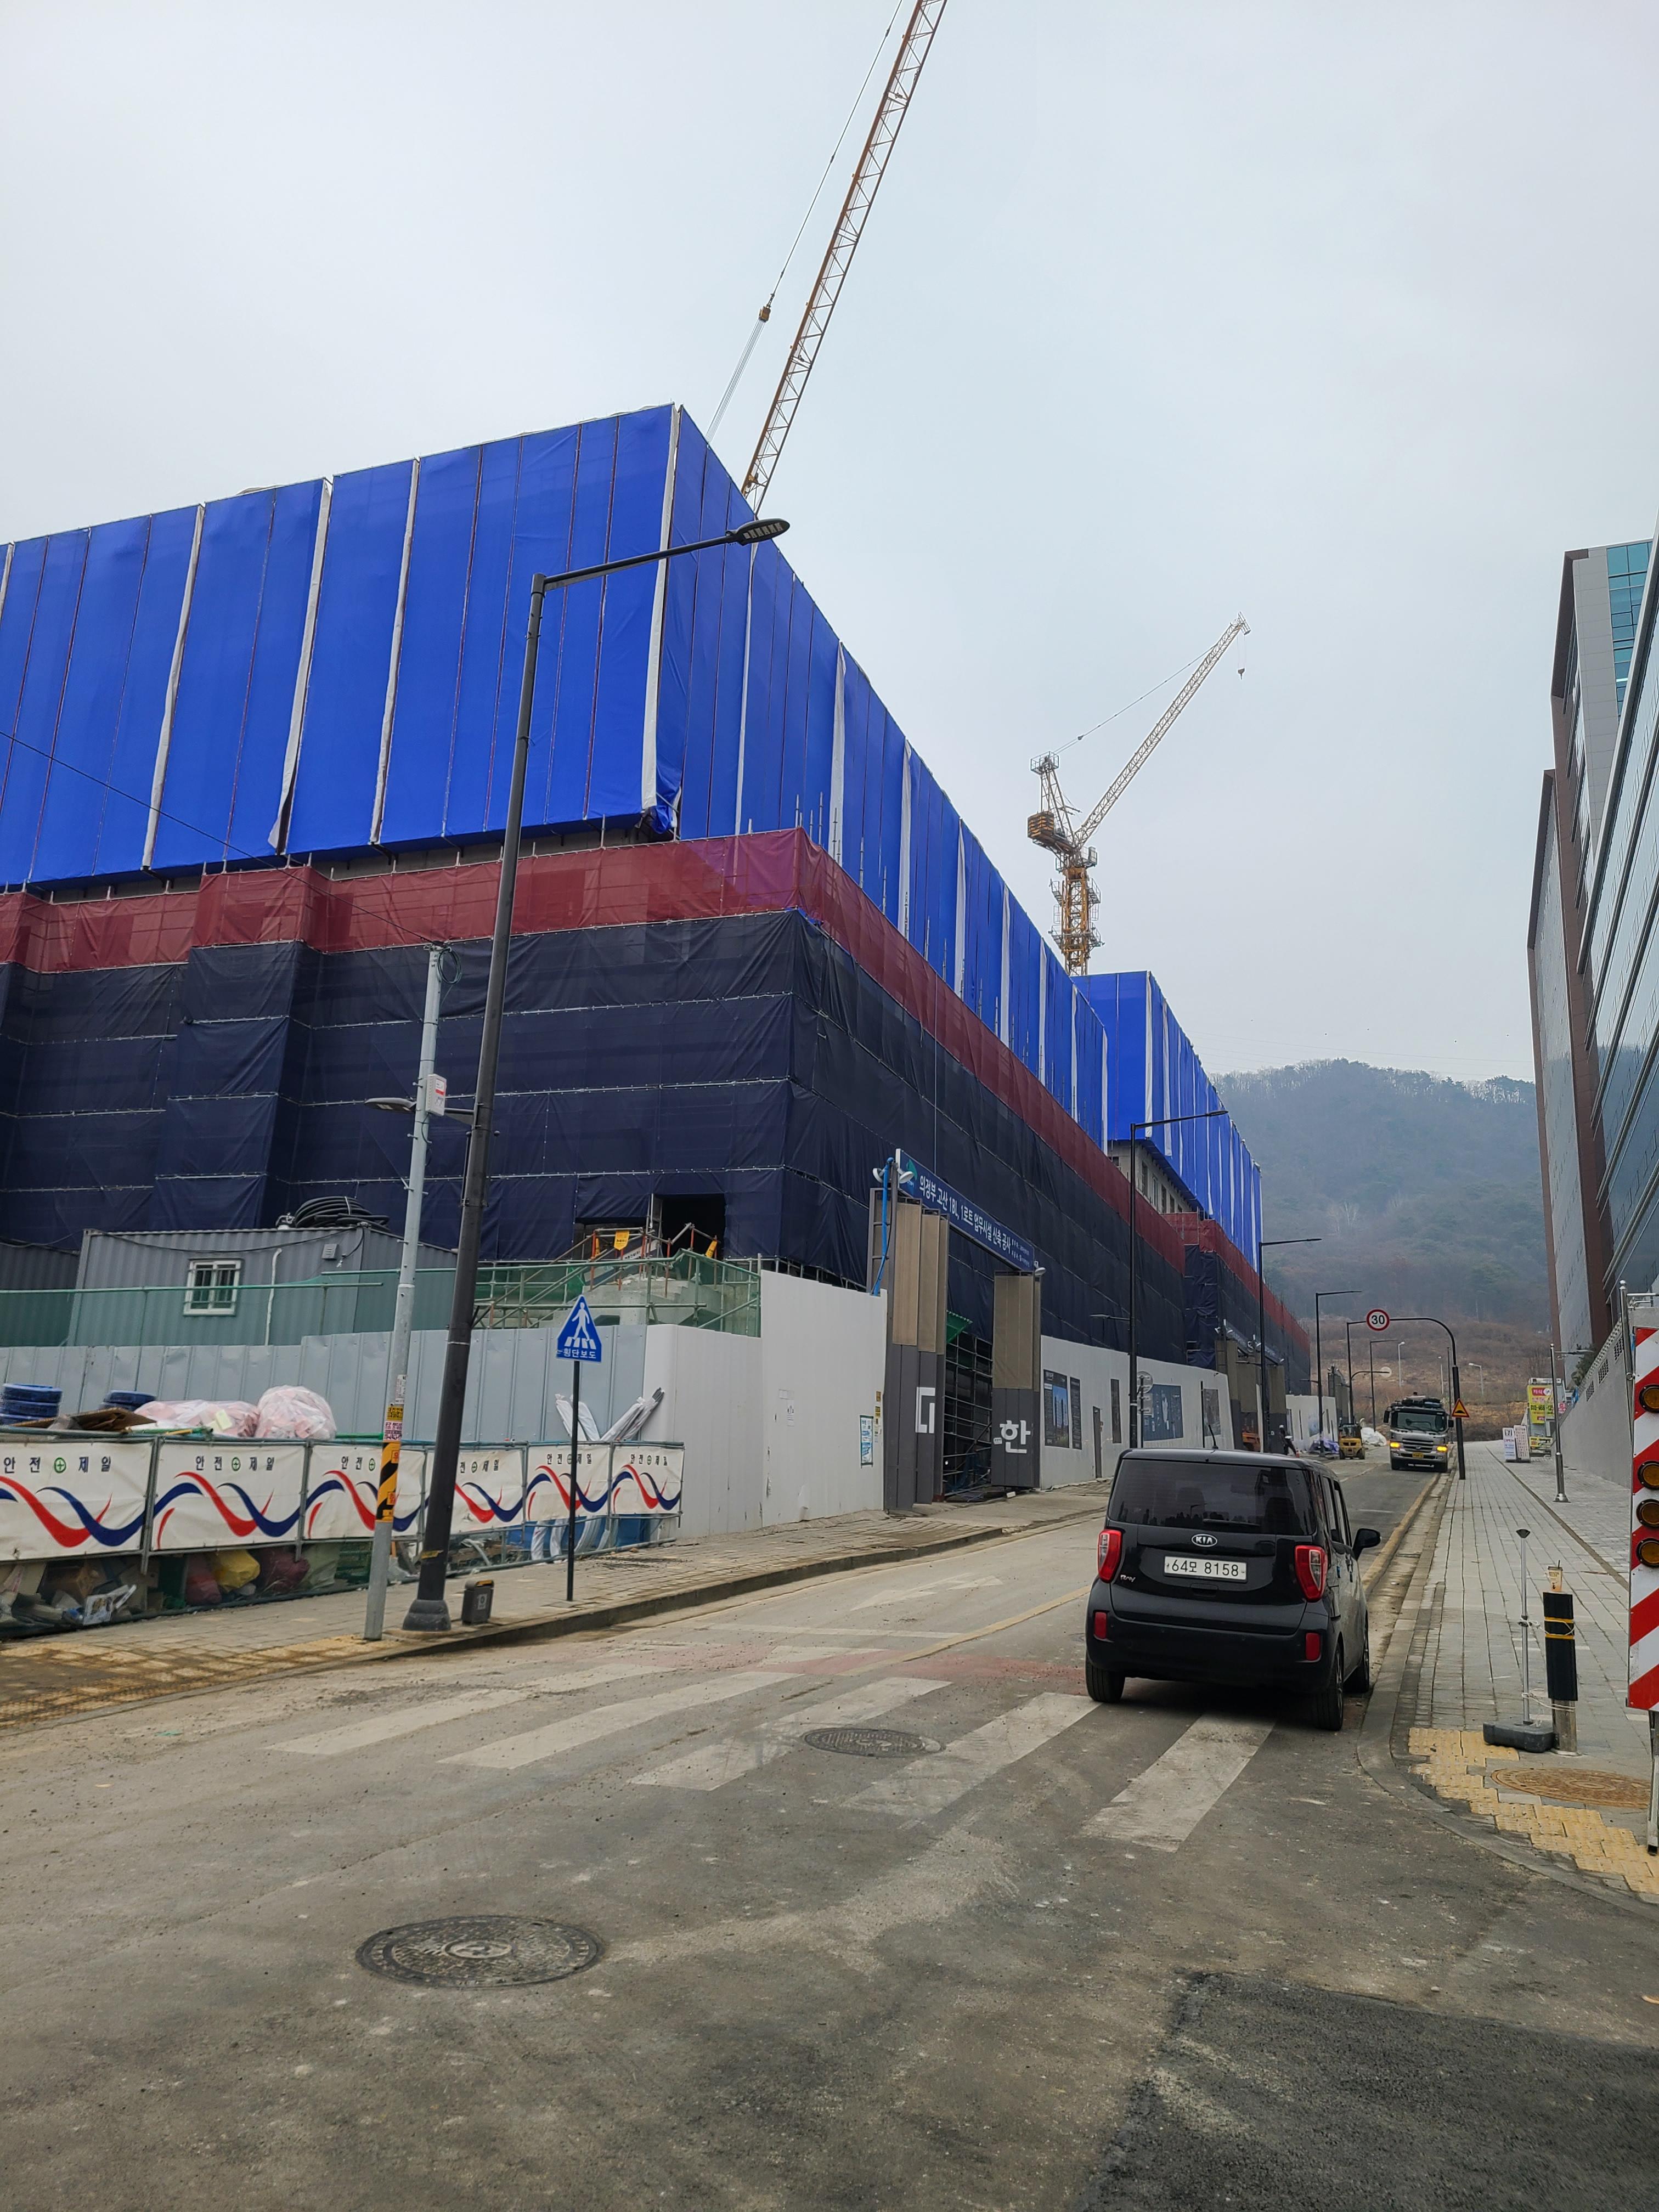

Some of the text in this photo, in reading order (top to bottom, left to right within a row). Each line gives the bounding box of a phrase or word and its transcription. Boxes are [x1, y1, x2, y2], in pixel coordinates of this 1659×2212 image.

[919, 1176, 936, 1203] 의정부
[937, 1188, 948, 1211] 고산
[961, 1205, 974, 1226] 1로트
[974, 1213, 992, 1242] 업무시설
[1372, 1314, 1385, 1325] 30
[563, 1348, 596, 1359] 횡단보도
[999, 1420, 1031, 1454] 한
[1195, 1536, 1213, 1544] KIA
[1172, 1559, 1238, 1577] 64모 8158
